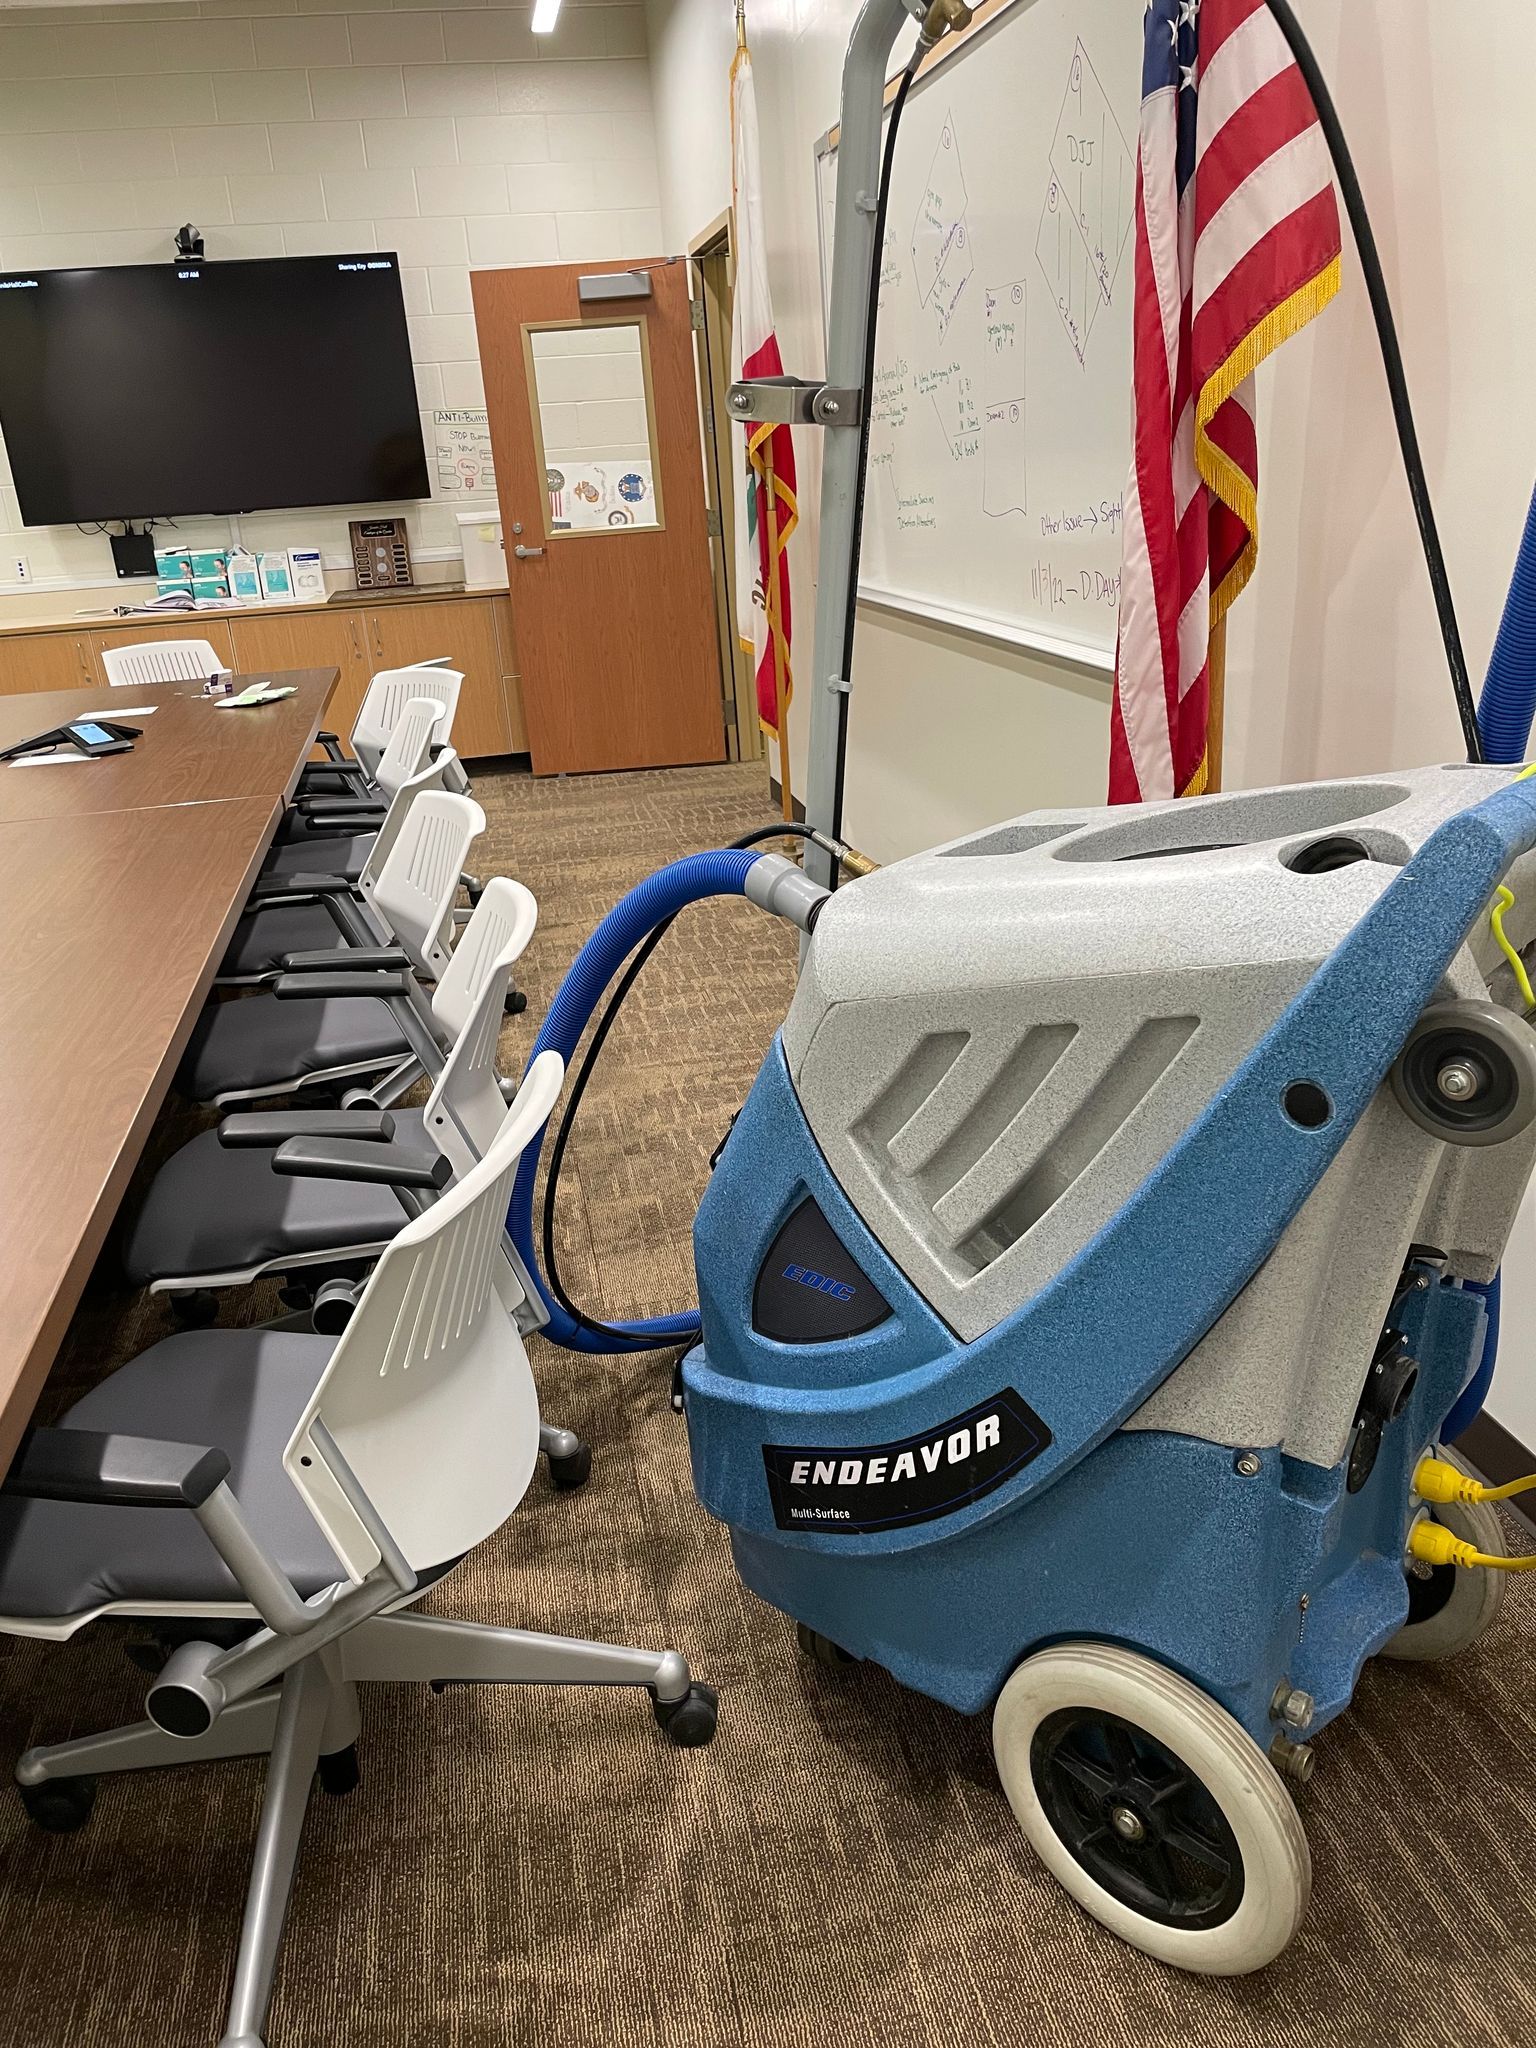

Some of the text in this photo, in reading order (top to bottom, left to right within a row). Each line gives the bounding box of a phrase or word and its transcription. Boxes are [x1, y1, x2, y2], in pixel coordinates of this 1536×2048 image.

[1066, 134, 1095, 167] DJJ
[449, 430, 468, 440] STOP
[782, 1263, 856, 1301] EDIC
[790, 1413, 1001, 1485] ENDEAVOR
[790, 1507, 851, 1520] Multi-Surface
